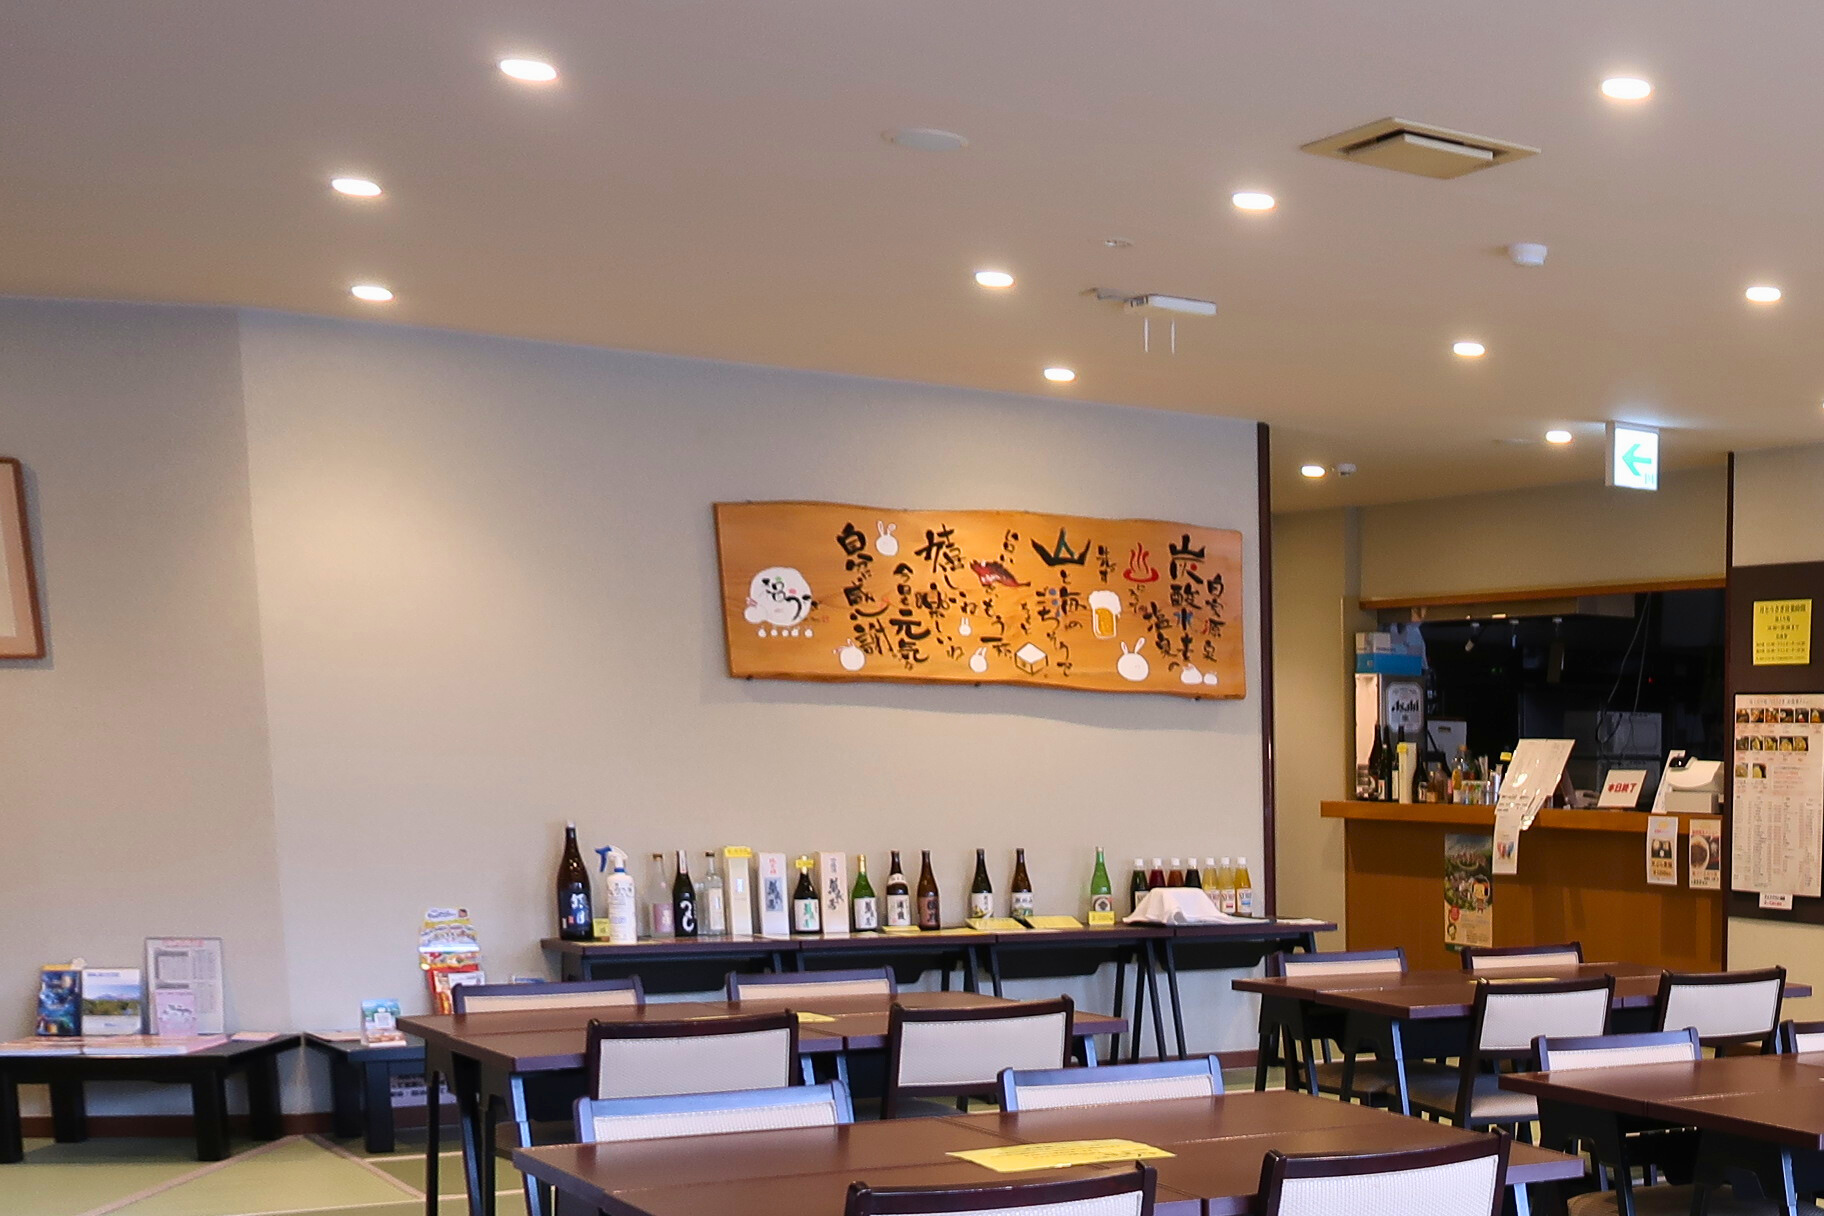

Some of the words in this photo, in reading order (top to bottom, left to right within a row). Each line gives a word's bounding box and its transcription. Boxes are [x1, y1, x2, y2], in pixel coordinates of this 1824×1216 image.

[1391, 699, 1420, 712] Asahi
[1607, 782, 1638, 793] 本日終了
